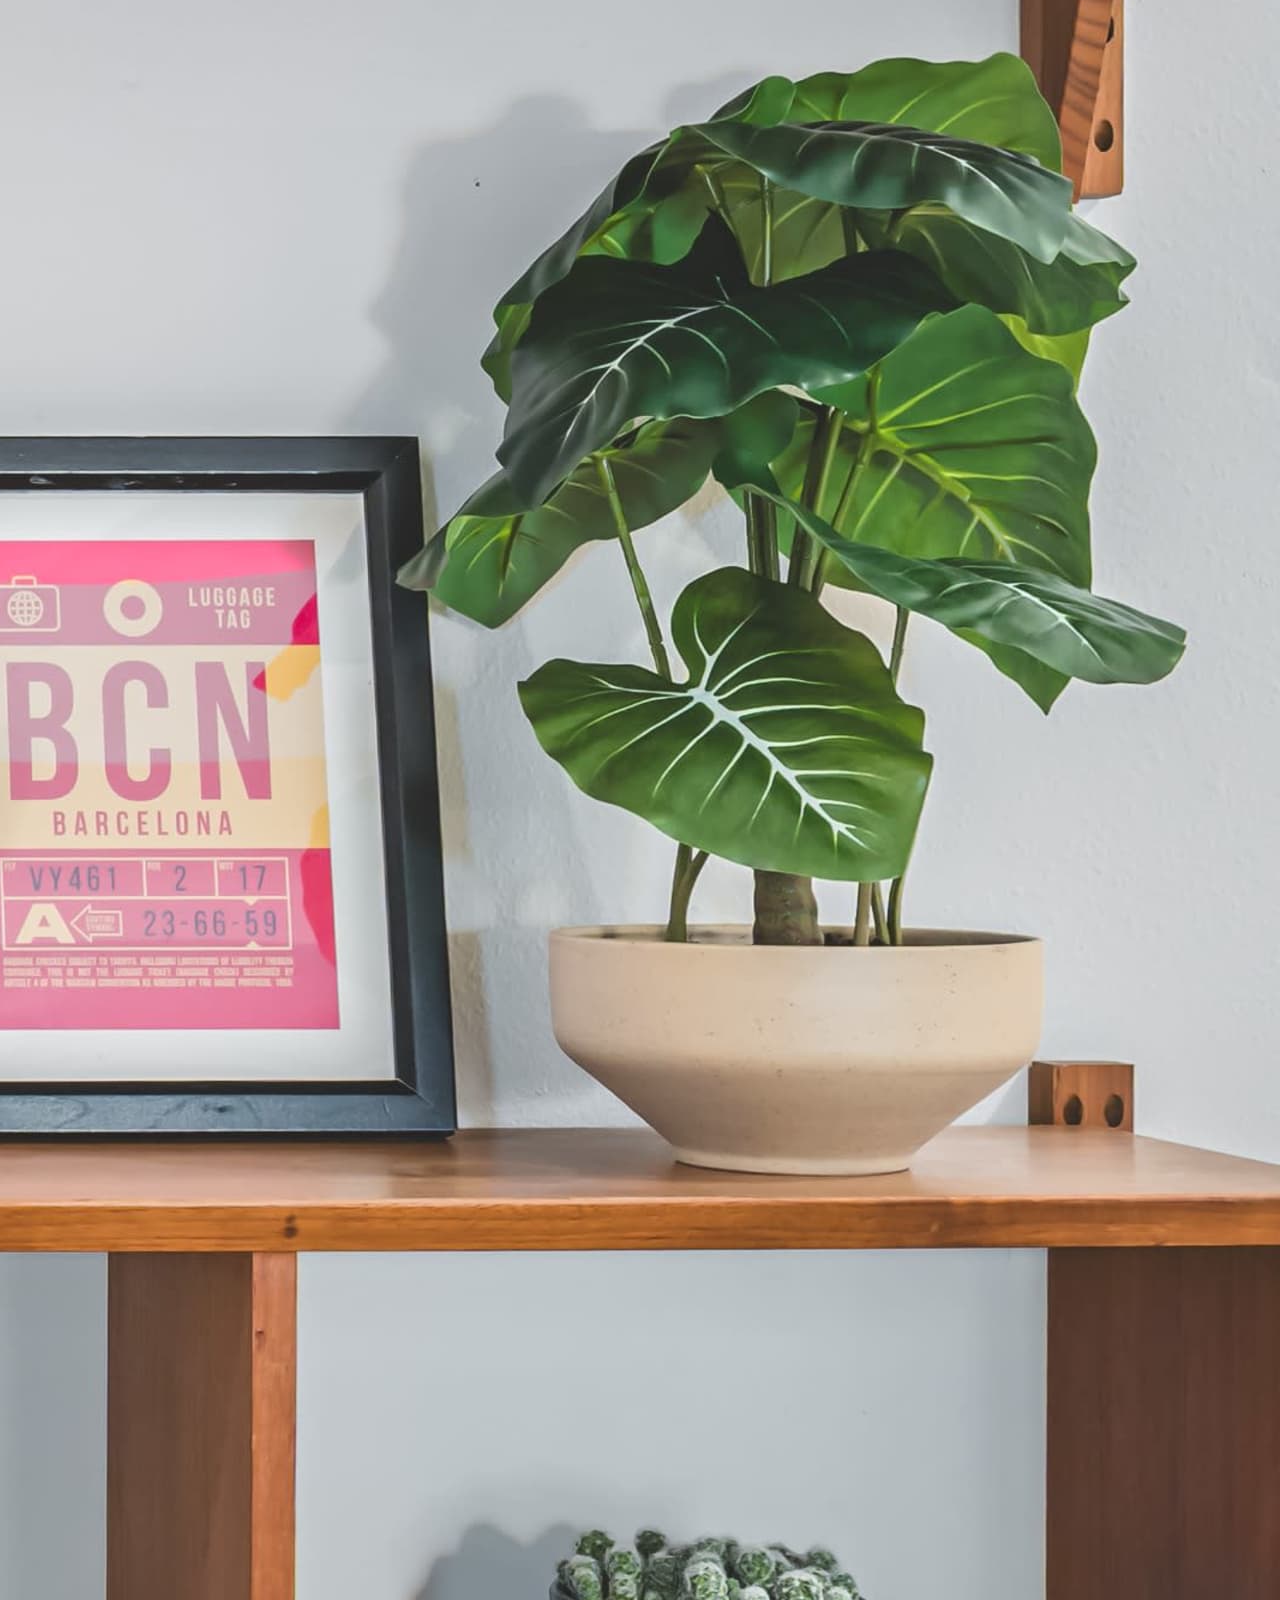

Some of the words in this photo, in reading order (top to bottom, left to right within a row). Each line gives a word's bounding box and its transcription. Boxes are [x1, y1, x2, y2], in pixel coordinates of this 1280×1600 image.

[189, 587, 276, 607] LUGGAGE
[215, 608, 251, 629] TAG
[5, 659, 273, 801] BCN
[53, 810, 234, 836] BARCELONA
[29, 865, 116, 891] VY461
[174, 865, 187, 891] 2
[238, 865, 267, 891] 17
[15, 903, 76, 944] A
[143, 909, 278, 937] 23-66-59
